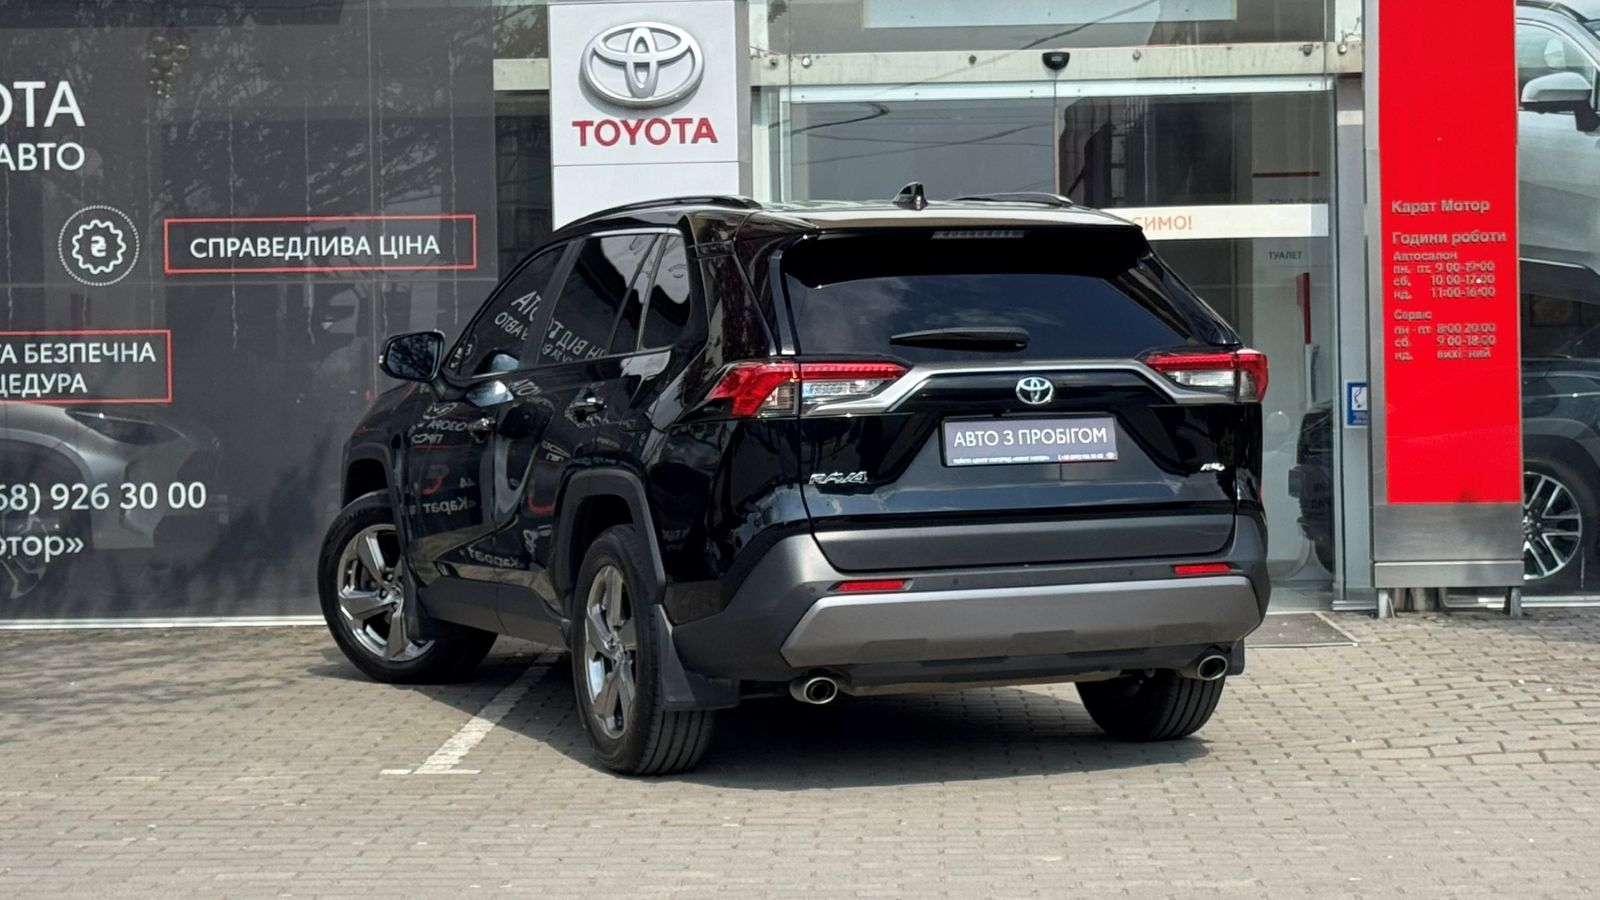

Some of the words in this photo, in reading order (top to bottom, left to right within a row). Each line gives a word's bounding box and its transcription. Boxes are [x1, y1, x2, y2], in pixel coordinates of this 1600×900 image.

[571, 117, 719, 147] TOYOTA
[1391, 200, 1437, 215] Карат
[1441, 198, 1490, 213] Мотор
[189, 236, 371, 261] СПРАВЕДЛИВА
[378, 234, 442, 258] ЦІНА
[1392, 231, 1448, 247] Години
[1451, 229, 1507, 246] роботи
[1268, 250, 1303, 260] ТУАЛЕТ
[1393, 251, 1458, 262] Автосалон
[24, 342, 157, 364] БЕЗПЕЧНА
[953, 431, 1000, 447] АВТО
[1018, 427, 1108, 445] ПРОБІГОМ
[50, 482, 110, 511] 926
[119, 481, 158, 510] 30
[168, 481, 207, 510] 00
